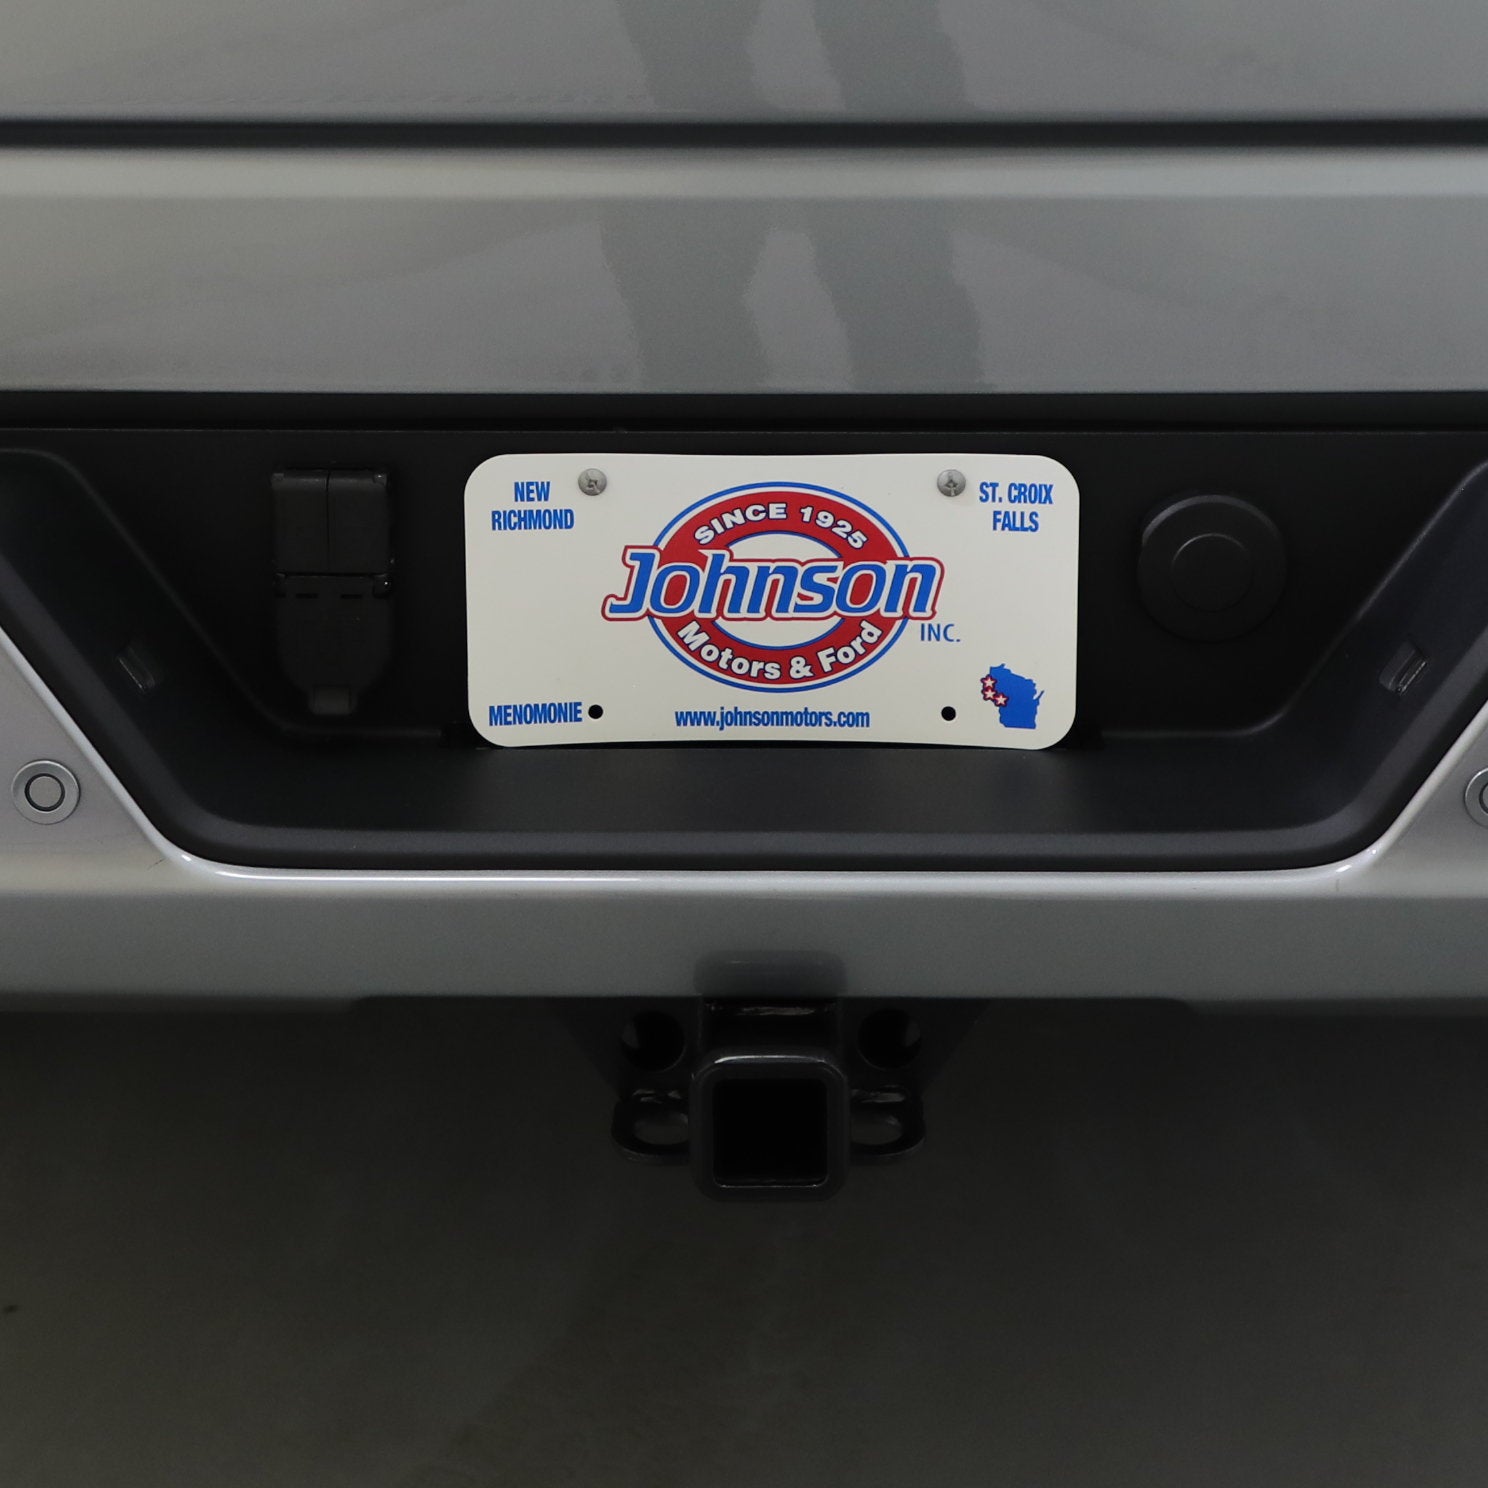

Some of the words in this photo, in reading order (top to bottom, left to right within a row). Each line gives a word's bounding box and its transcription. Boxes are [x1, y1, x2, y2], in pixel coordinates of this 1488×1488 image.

[513, 481, 551, 502] NEW
[978, 482, 1003, 504] ST.
[1007, 483, 1054, 506] CROIX
[491, 509, 575, 531] RICHMOND
[693, 502, 788, 546] SINCE
[799, 505, 869, 550] 1925
[992, 510, 1039, 533] FALLS
[607, 550, 939, 616] Johnson
[919, 622, 962, 643] INC.
[676, 619, 782, 680] Motors
[789, 656, 815, 680] &
[816, 619, 883, 673] Ford
[488, 701, 582, 727] MENOMONIE
[675, 707, 870, 731] www.johnsonmotors.com
